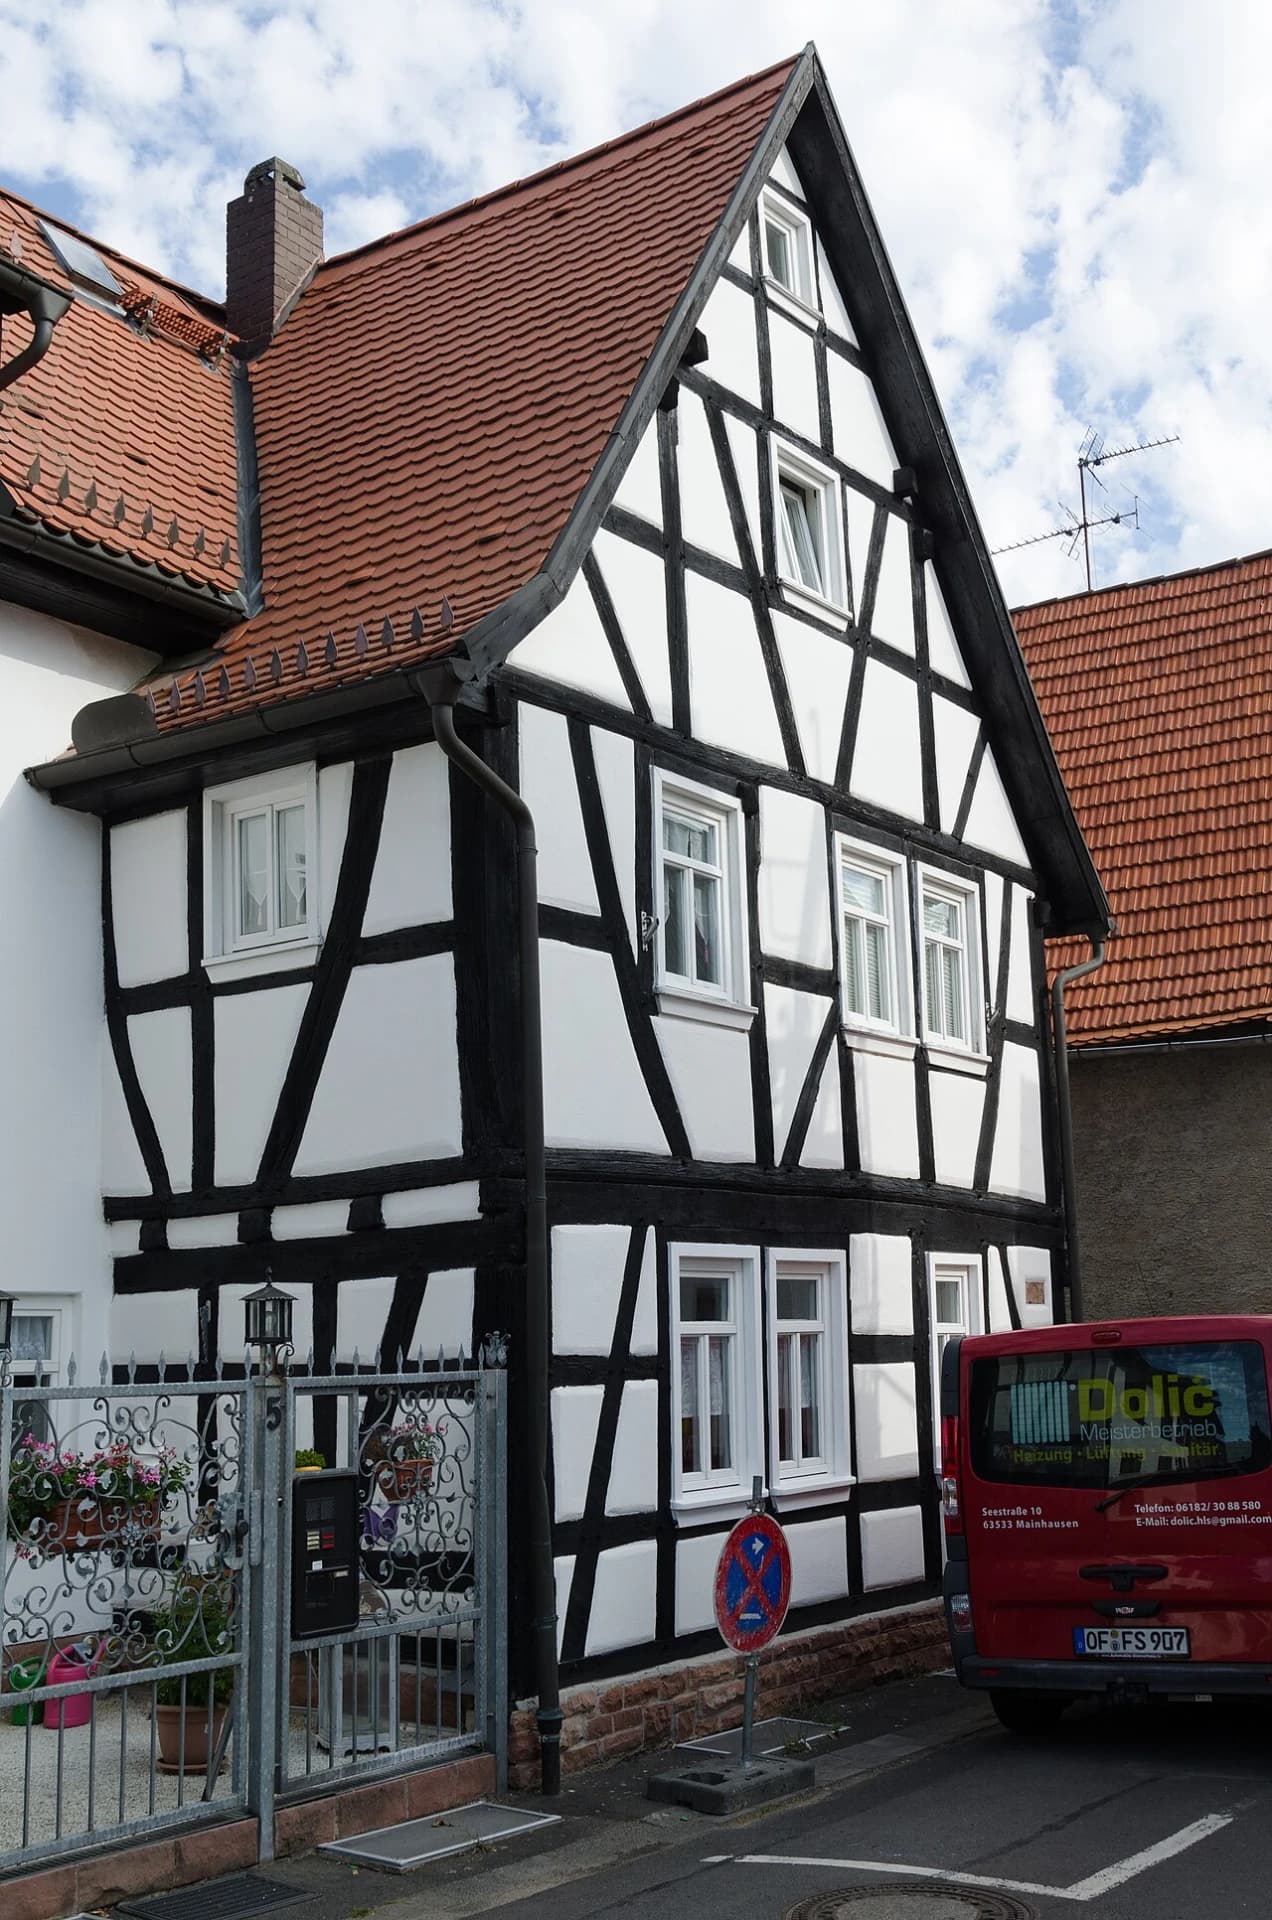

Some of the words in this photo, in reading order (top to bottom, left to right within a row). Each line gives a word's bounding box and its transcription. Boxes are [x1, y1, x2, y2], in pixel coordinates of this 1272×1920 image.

[267, 1396, 281, 1431] 5
[1080, 1418, 1216, 1441] Meisterbetrieb
[1014, 1448, 1072, 1464] Heizung
[982, 1506, 1028, 1516] Seestraße
[1030, 1506, 1042, 1515] 10
[1135, 1504, 1174, 1513] Telefon:
[1175, 1502, 1210, 1513] 06182/
[1213, 1502, 1226, 1511] 30
[1227, 1501, 1240, 1510] 88
[1242, 1501, 1261, 1510] 580
[983, 1520, 1013, 1529] 63533
[1016, 1519, 1079, 1529] Mainhausen
[1136, 1517, 1169, 1526] E-Mail:
[1170, 1514, 1272, 1526] dolic.hls@gmail.com
[1086, 1632, 1109, 1650] OF
[1122, 1632, 1146, 1650] FS
[1150, 1631, 1185, 1651] 907
